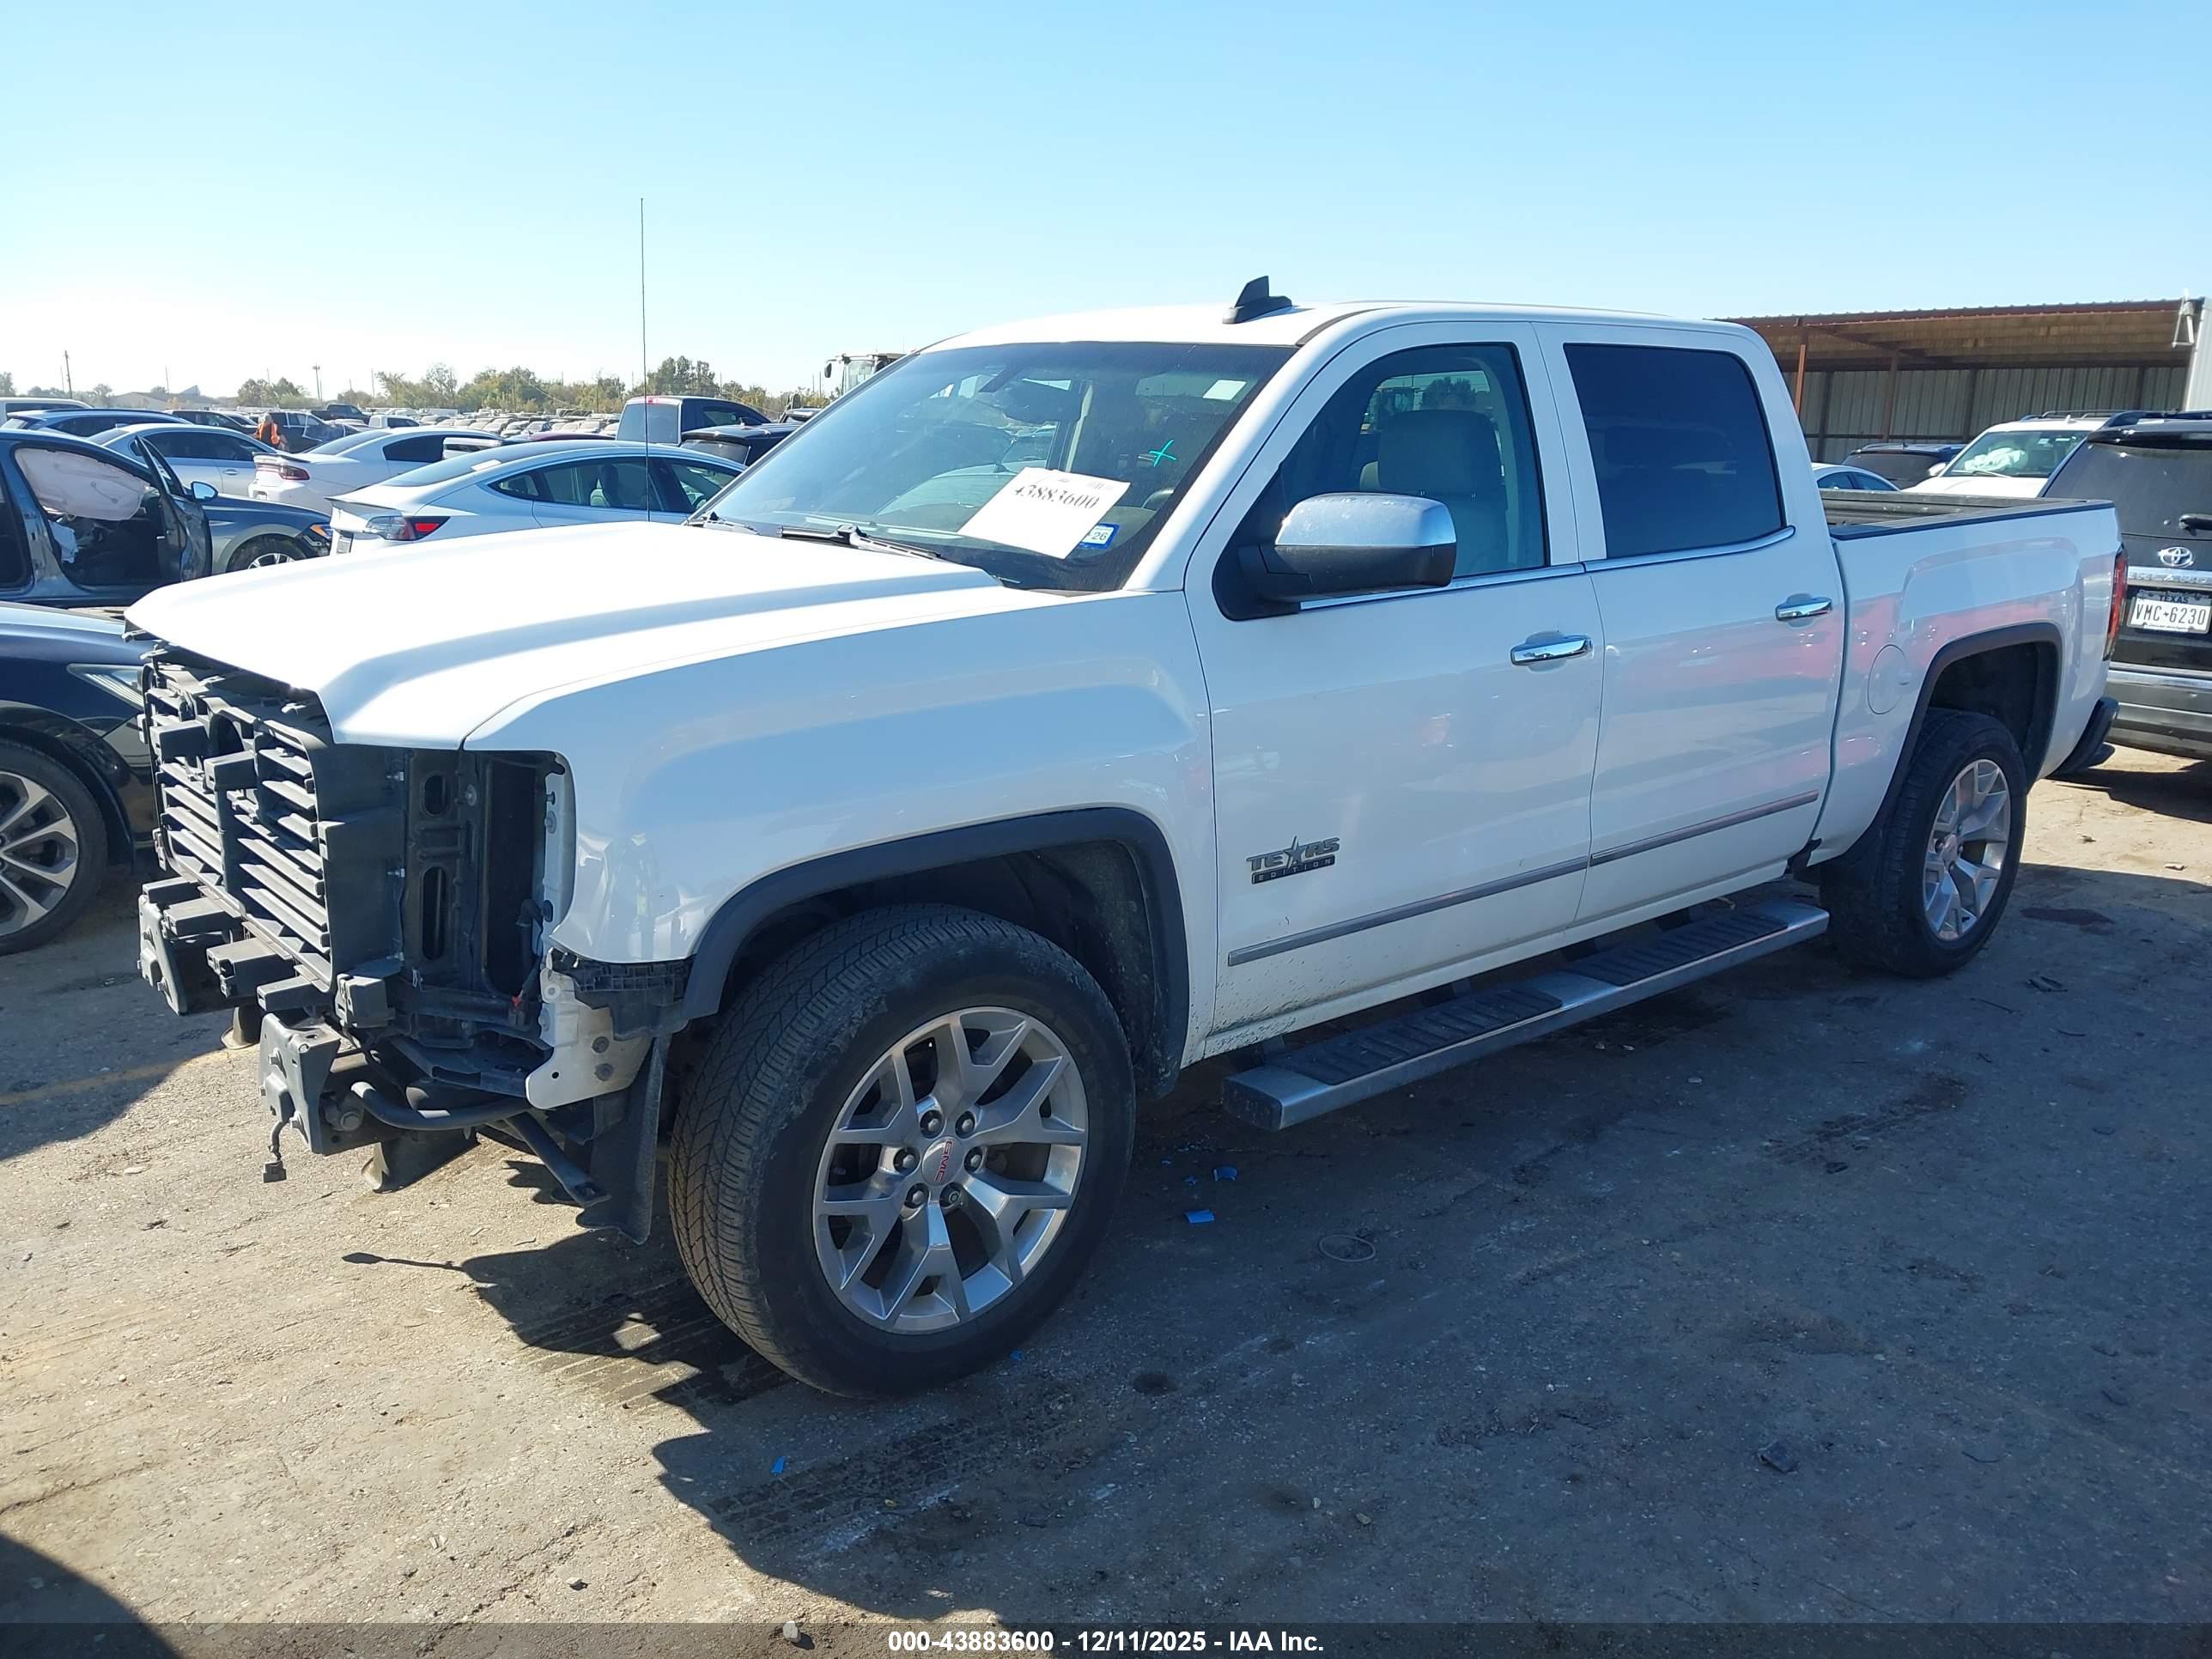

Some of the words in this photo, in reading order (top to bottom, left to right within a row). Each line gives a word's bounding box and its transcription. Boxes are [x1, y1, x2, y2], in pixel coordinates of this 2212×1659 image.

[2158, 594, 2189, 604] TEXAS
[1246, 836, 1340, 871] TEXAS
[1258, 858, 1332, 880] EDITION
[933, 1139, 954, 1182] GMC
